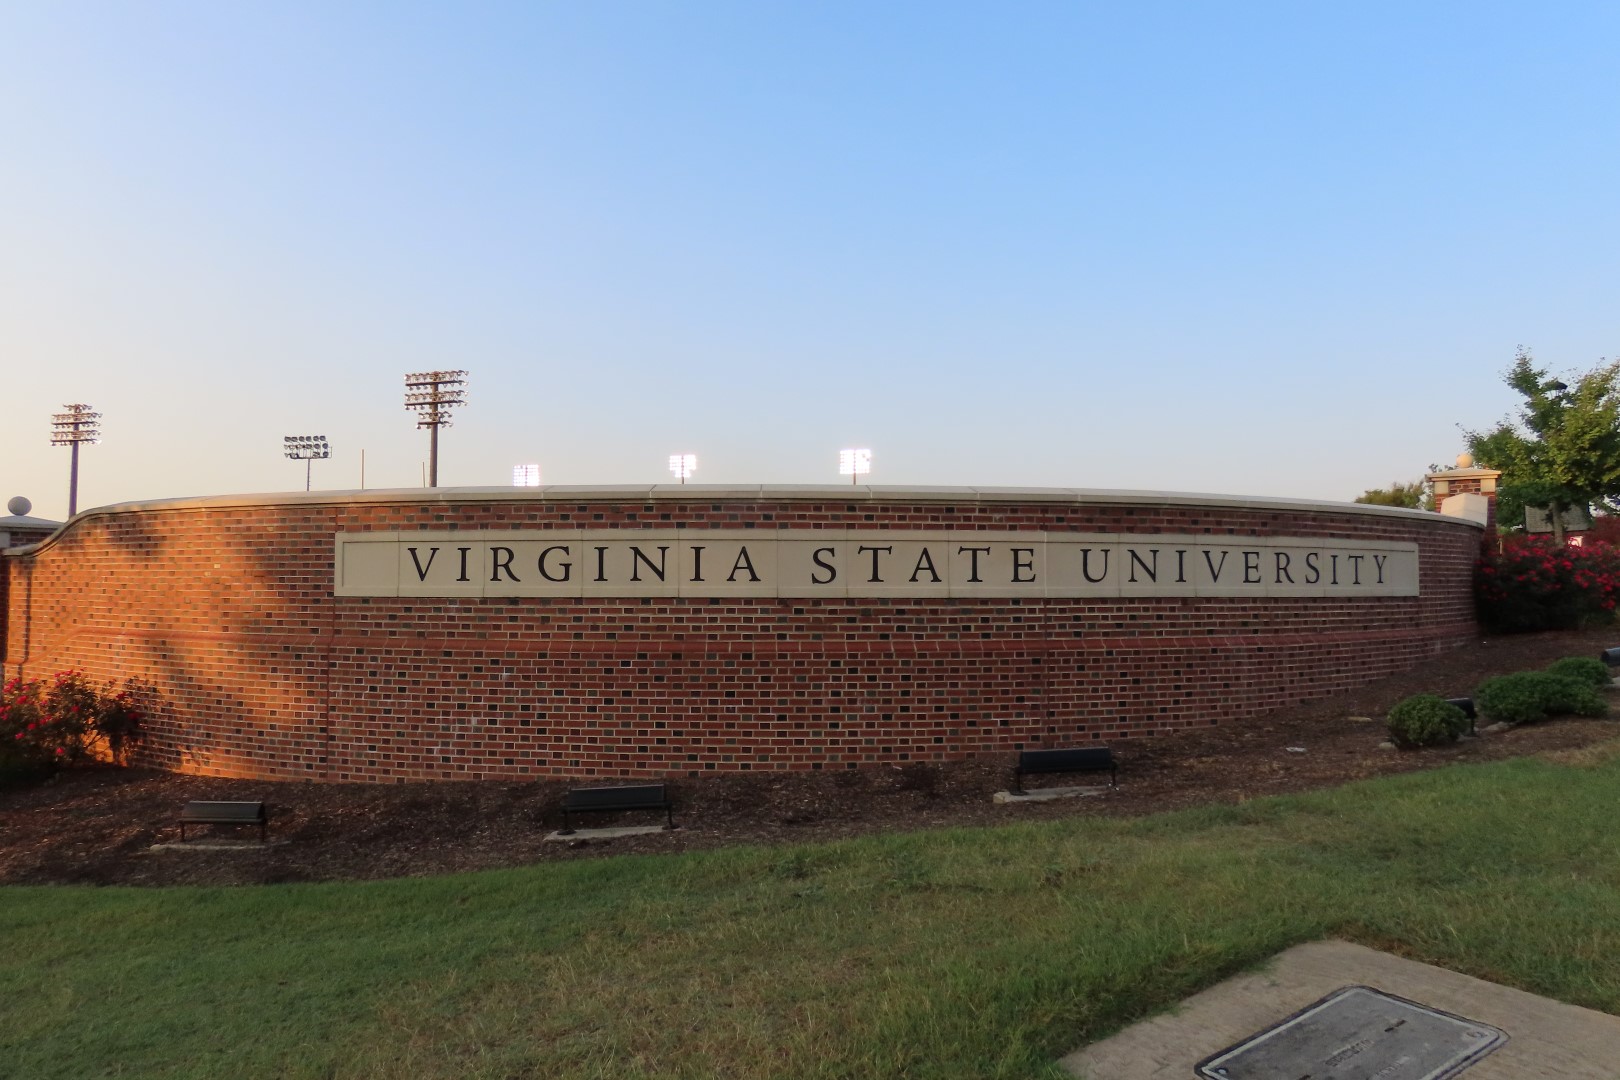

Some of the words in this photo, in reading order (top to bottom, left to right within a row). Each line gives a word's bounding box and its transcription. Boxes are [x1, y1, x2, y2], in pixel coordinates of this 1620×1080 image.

[408, 546, 762, 583] VIRGINIA
[811, 545, 1037, 585] STATE
[1080, 548, 1388, 585] UNIVERSITY
